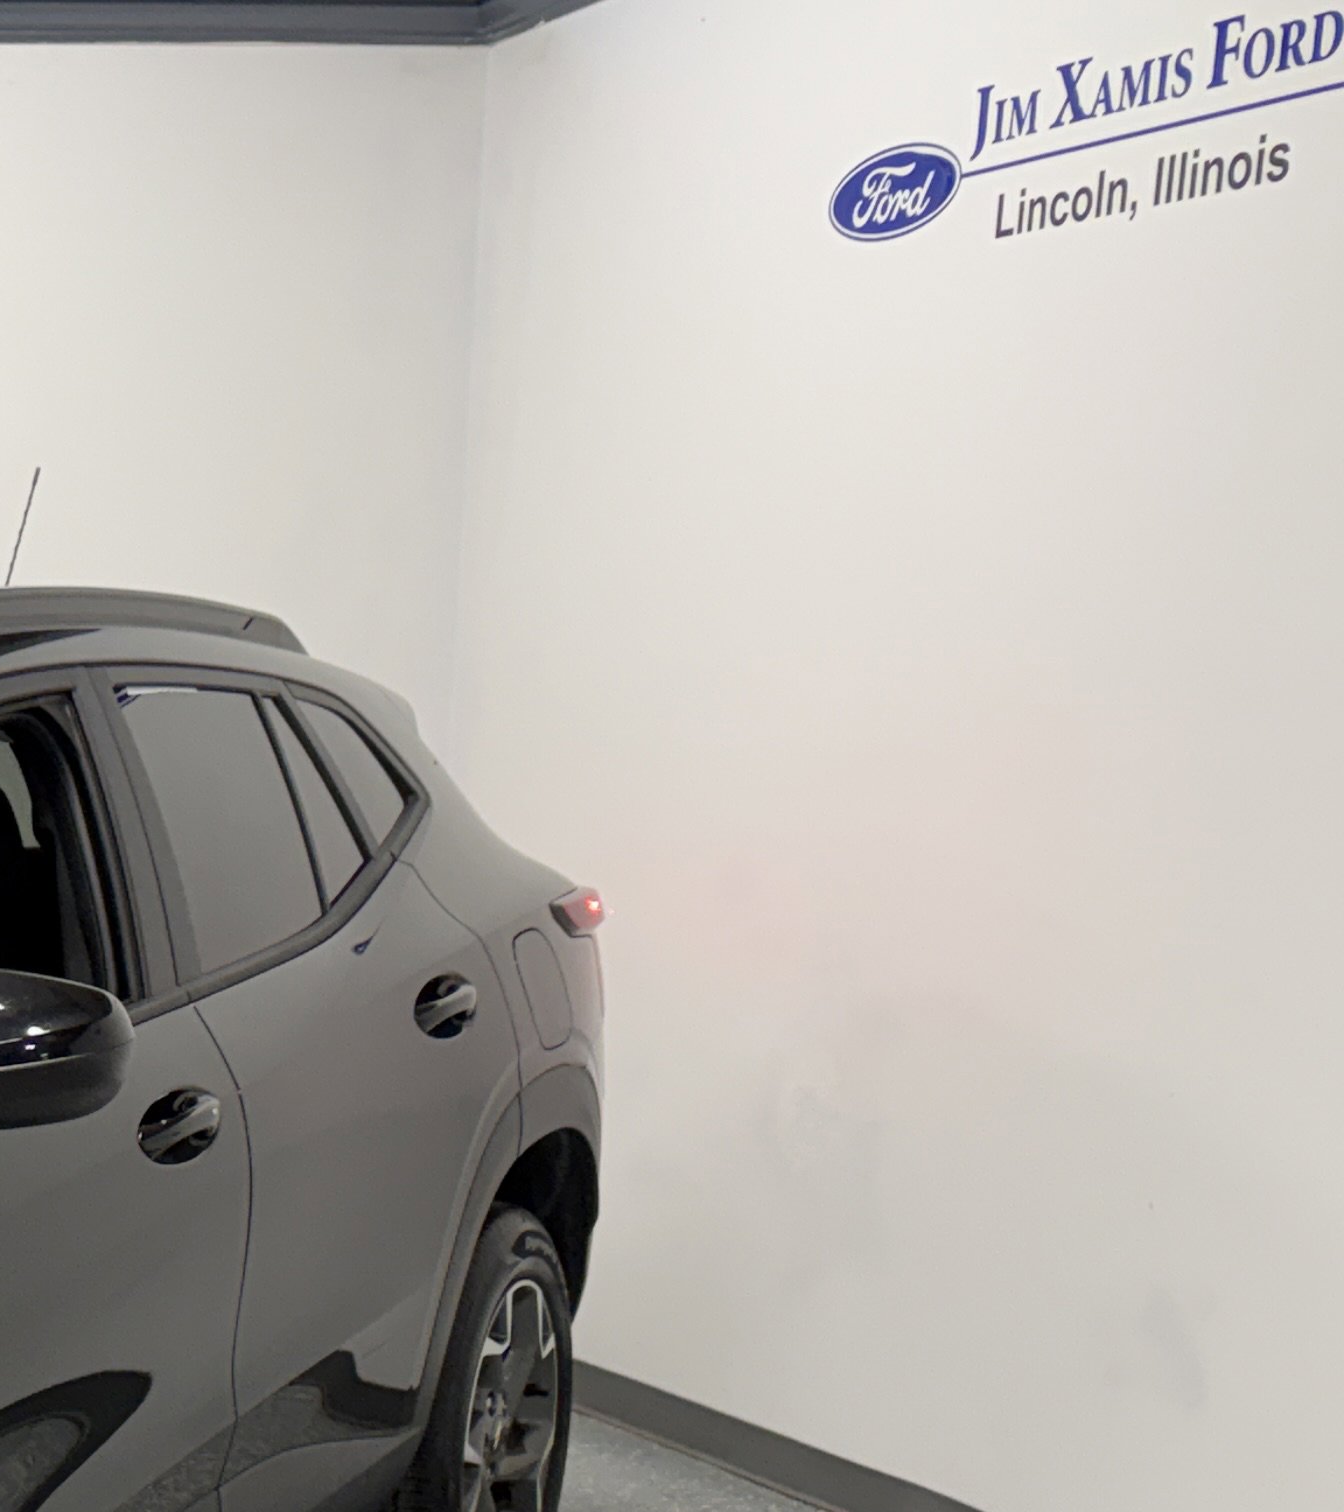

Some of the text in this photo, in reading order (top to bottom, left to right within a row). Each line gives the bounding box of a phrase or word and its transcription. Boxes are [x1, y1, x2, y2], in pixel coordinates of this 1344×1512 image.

[970, 10, 1344, 162] JIM XAMIS FORD
[851, 160, 933, 230] Ford
[994, 133, 1291, 239] Lincoln, Illinois
